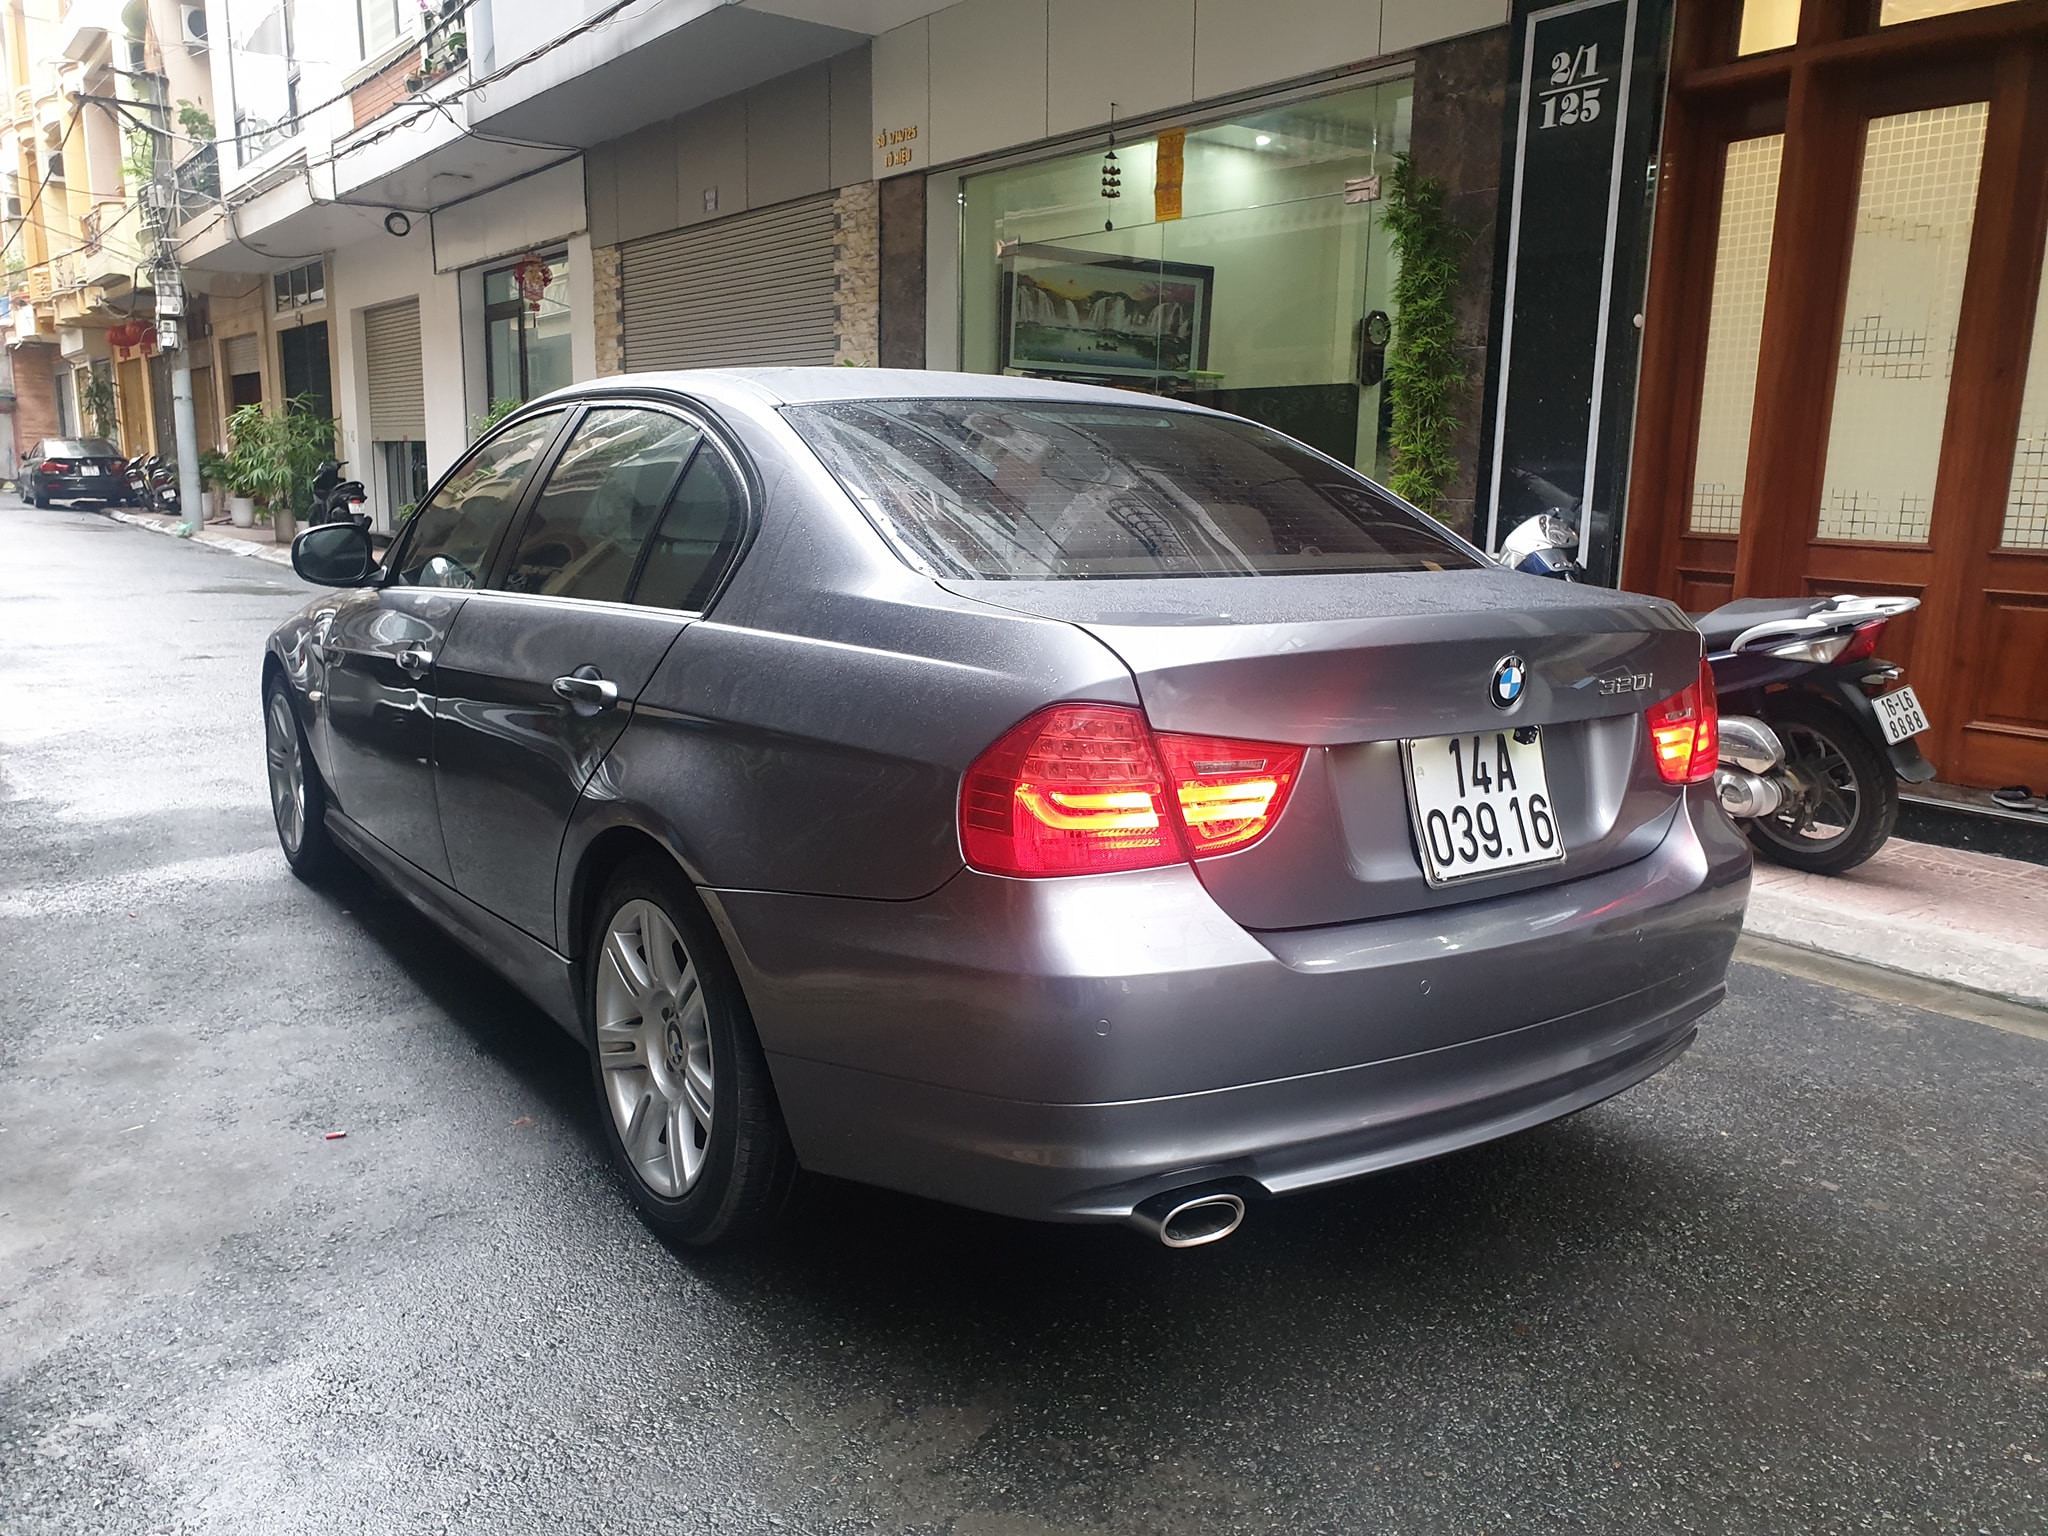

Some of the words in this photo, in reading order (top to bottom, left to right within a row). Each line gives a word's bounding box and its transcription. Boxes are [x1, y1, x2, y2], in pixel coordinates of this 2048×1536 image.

[1551, 43, 1599, 85] 2/1
[1539, 88, 1601, 129] 125
[1599, 672, 1654, 696] 320i
[1881, 690, 1914, 719] 16-L6
[1889, 710, 1923, 739] 8888
[1449, 733, 1517, 798] 14A
[1427, 793, 1554, 866] 039.16
